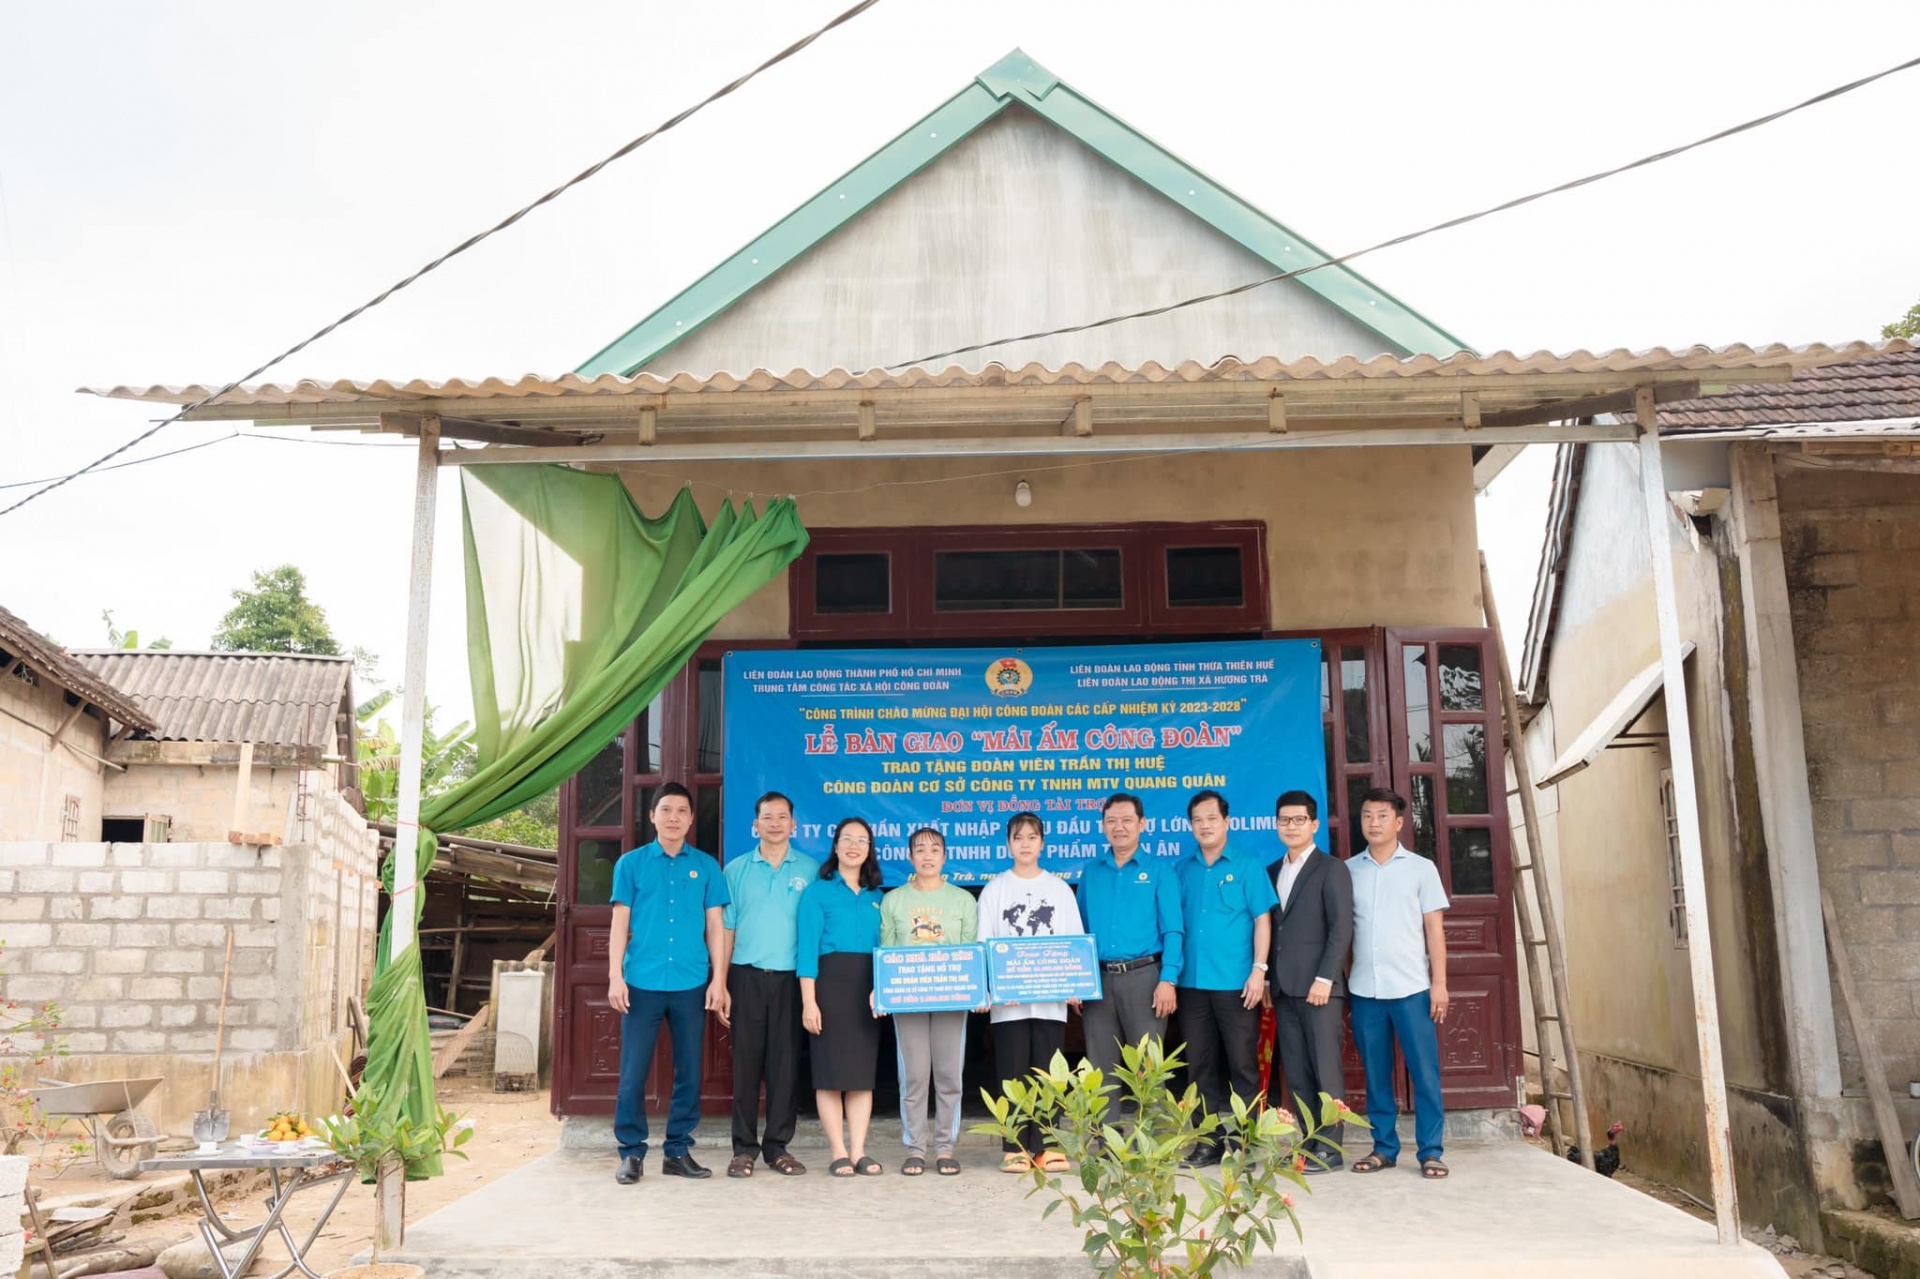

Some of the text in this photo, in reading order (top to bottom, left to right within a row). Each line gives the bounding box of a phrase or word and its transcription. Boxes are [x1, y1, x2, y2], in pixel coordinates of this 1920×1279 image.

[744, 669, 764, 680] LIÊN
[767, 668, 793, 679] ĐOÀN
[796, 669, 813, 679] LAO
[816, 668, 842, 680] ĐỘNG
[845, 667, 876, 678] THÀNH
[917, 666, 933, 677] CHÍ
[935, 667, 961, 676] MINH
[1070, 664, 1091, 674] LIÊN
[1094, 663, 1120, 674] ĐOÀN
[1123, 664, 1141, 673] LAO
[1144, 662, 1170, 673] ĐỘNG
[1225, 660, 1253, 670] THIÊN
[1256, 658, 1275, 670] HUẾ
[753, 683, 784, 693] TRUNG
[787, 682, 807, 692] TÂM
[810, 682, 836, 692] CÔNG
[839, 681, 856, 692] TÁC
[875, 681, 891, 693] HỘI
[893, 681, 920, 691] CÔNG
[923, 680, 949, 690] ĐOÀN
[1077, 677, 1099, 687] LIÊN
[1101, 676, 1128, 687] ĐOÀN
[1131, 677, 1149, 686] LAO
[1152, 676, 1178, 687] ĐỘNG
[1180, 676, 1196, 687] THỊ
[1214, 675, 1247, 685] HƯƠNG
[1249, 673, 1268, 683] TRÀ
[840, 707, 874, 719] TRÌNH
[877, 706, 908, 719] CHÀO
[912, 706, 946, 718] MỪNG
[950, 706, 969, 720] ĐẠI
[973, 705, 992, 719] HỘI
[996, 704, 1028, 717] CÔNG
[1031, 703, 1063, 716] ĐOÀN
[1066, 702, 1090, 715] CÁC
[1093, 701, 1116, 715] CẤP
[1120, 702, 1158, 715] NHIỆM
[1161, 701, 1176, 714] KỲ
[805, 724, 838, 754] LỄ
[845, 727, 897, 754] BÀN
[903, 731, 964, 754] GIAO
[1037, 720, 1079, 751] ẤM
[1085, 723, 1154, 750] CÔNG
[882, 755, 1166, 775] TRAO TẶNG ĐOÀN VIÊN TRẦN THỊ HUỆ
[823, 773, 1226, 794] CÔNG ĐOÀN CƠ SỞ CÔNG TY TNHH MTV QUANG QUÂN
[941, 799, 973, 813] ĐƠN
[978, 800, 994, 815] VỊ
[998, 796, 1040, 812] ĐỒNG
[1044, 798, 1071, 811] TÀI
[802, 823, 822, 838] TY
[954, 819, 1001, 839] NHẬP
[1056, 815, 1091, 835] ĐẦU
[948, 845, 990, 860] TNHH
[1047, 838, 1096, 859] PHẨM
[1156, 840, 1181, 856] ÂN
